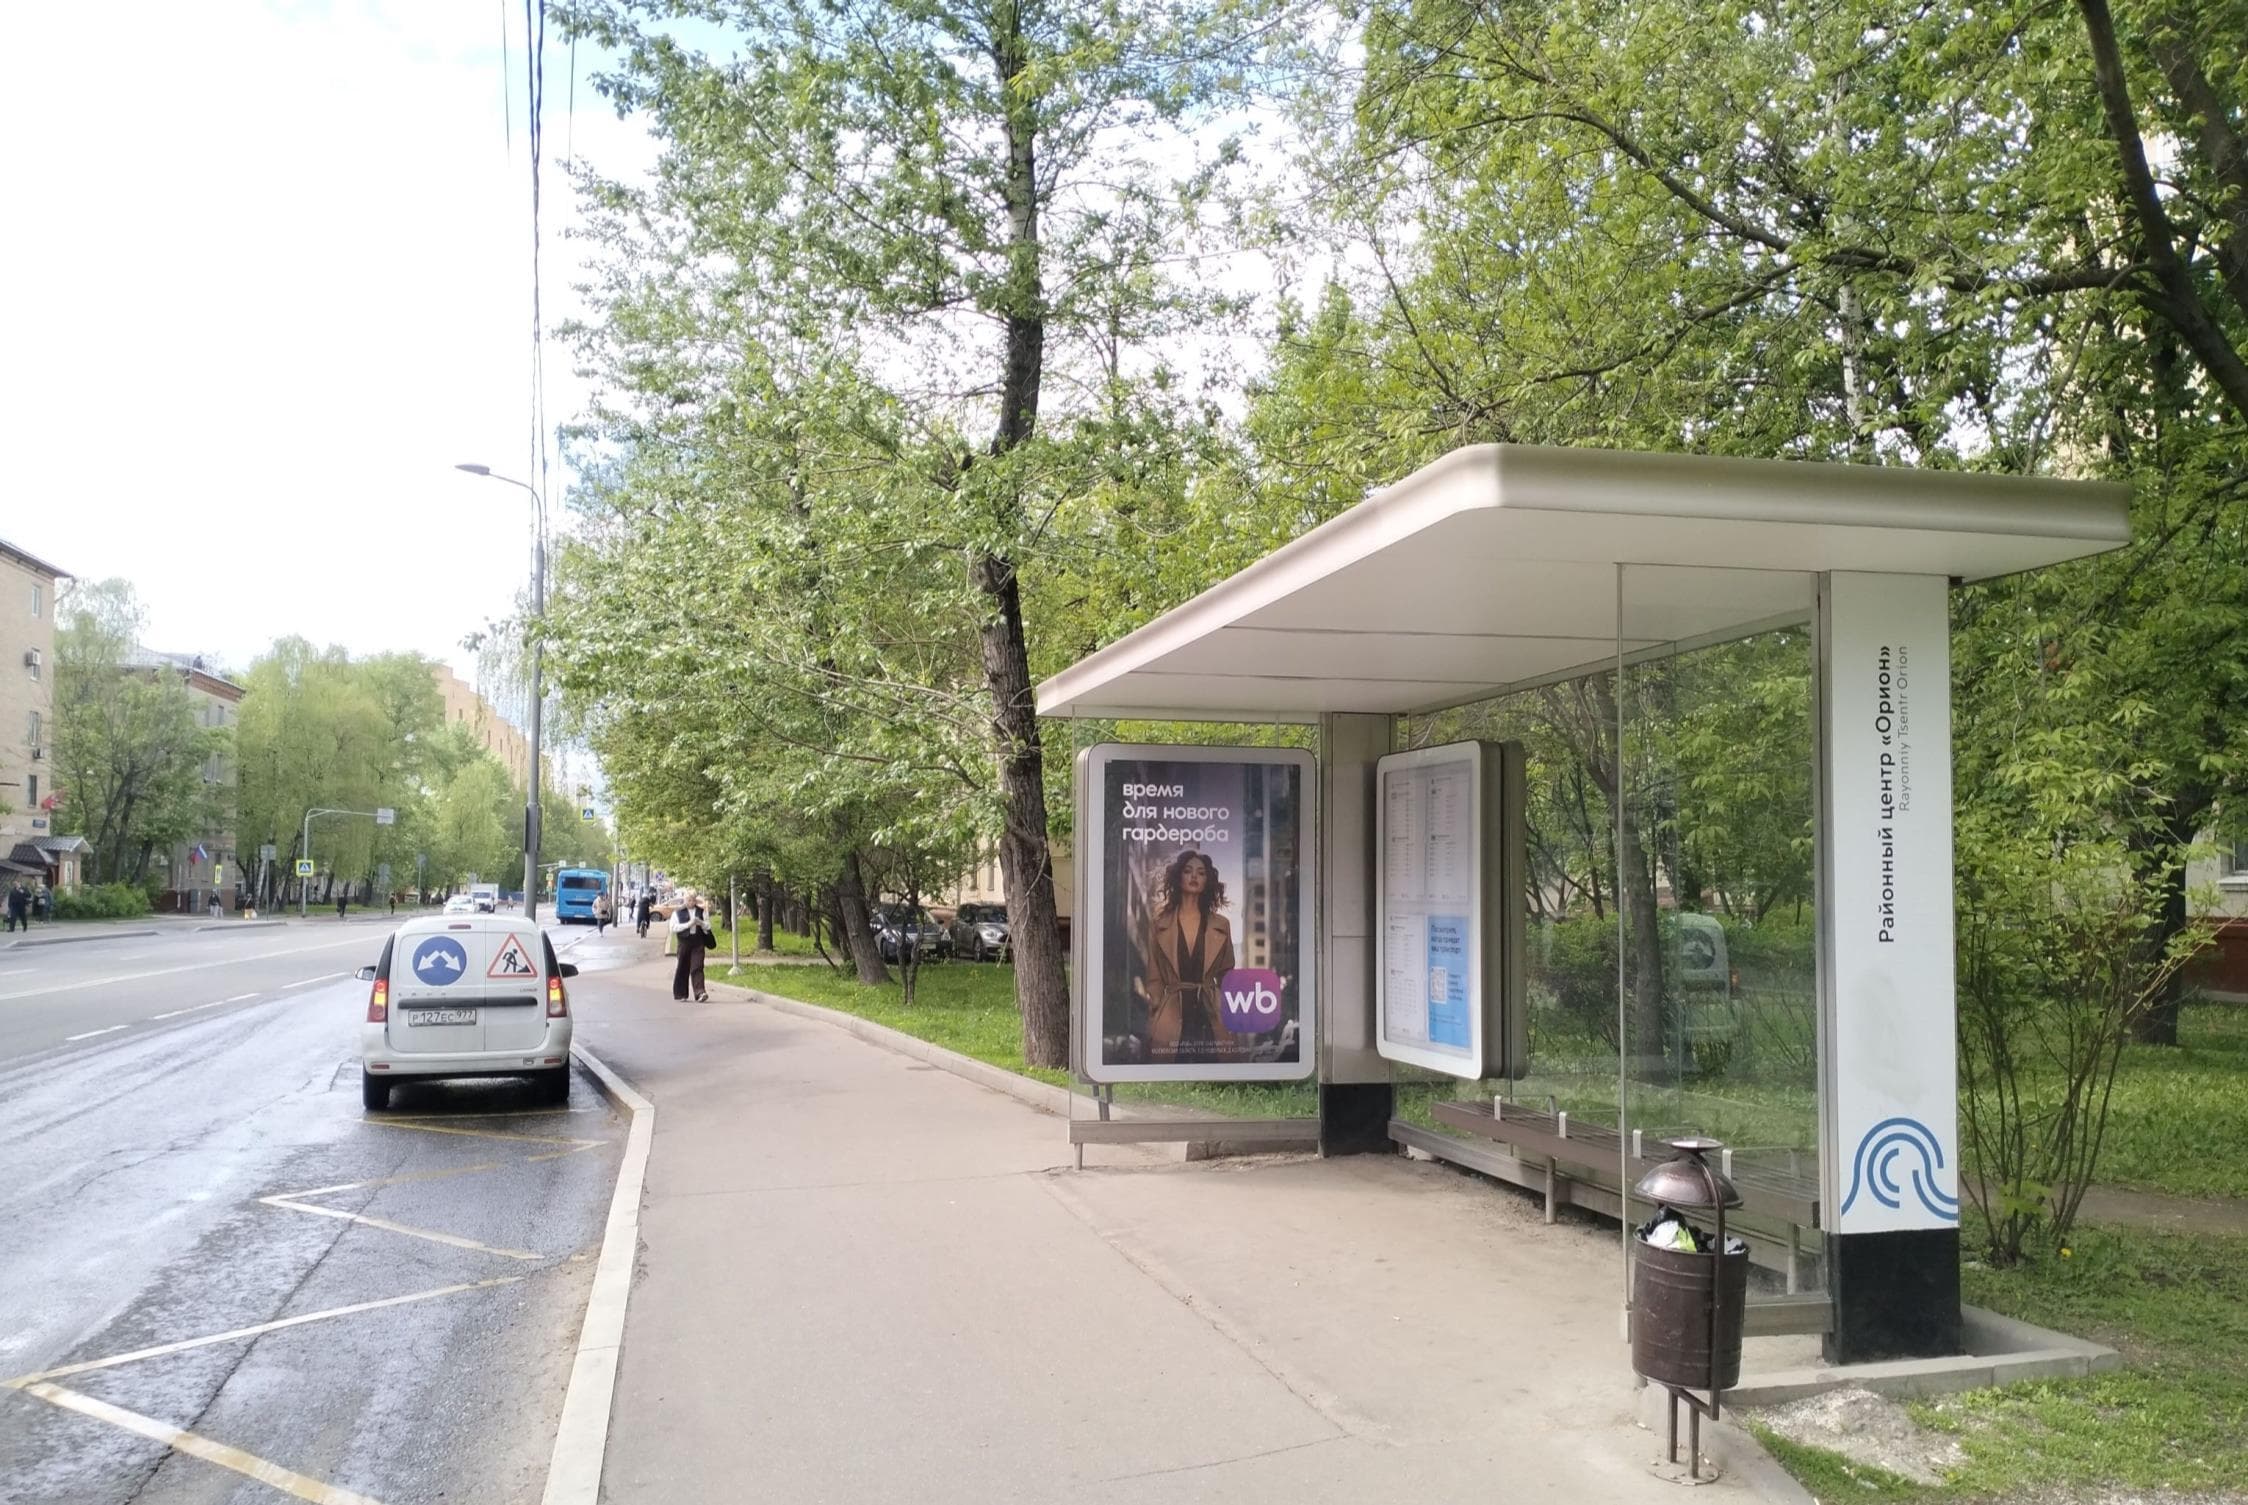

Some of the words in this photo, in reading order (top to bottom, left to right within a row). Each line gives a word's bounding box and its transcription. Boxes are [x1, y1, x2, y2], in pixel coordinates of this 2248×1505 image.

[1897, 645, 1909, 689] Orion
[1875, 645, 1895, 746] «Орион»
[1897, 693, 1909, 738] Tsentr
[1122, 782, 1184, 801] время
[1880, 752, 1895, 819] центр
[1899, 742, 1911, 812] Rayonniy
[1122, 801, 1158, 819] для
[1163, 806, 1230, 820] нового
[1122, 824, 1230, 846] гардероба
[1878, 827, 1895, 943] Районный
[1224, 981, 1278, 1015] wb
